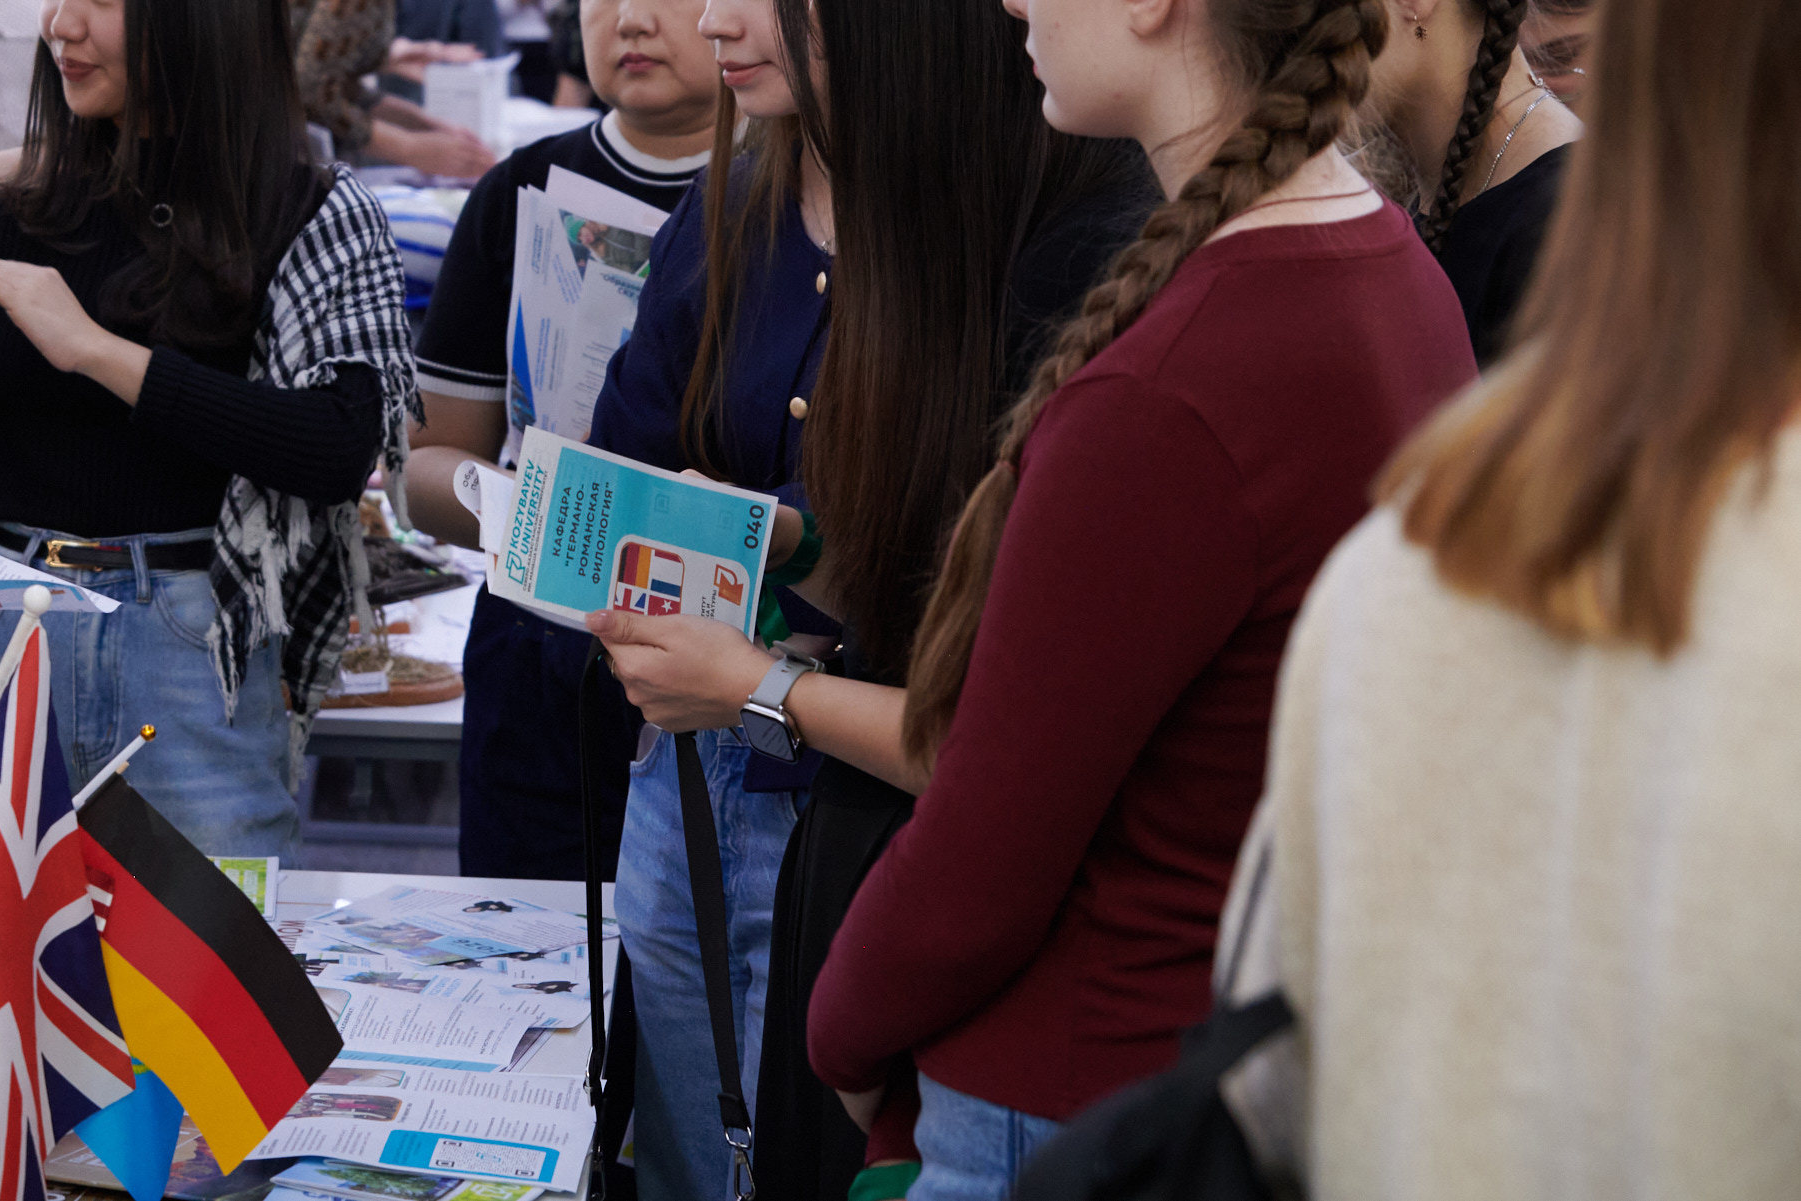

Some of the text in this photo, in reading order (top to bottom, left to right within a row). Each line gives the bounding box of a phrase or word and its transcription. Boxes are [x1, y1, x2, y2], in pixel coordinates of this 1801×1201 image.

[510, 459, 535, 549] KOZYBAYEV
[520, 465, 546, 554] UNIVERSITY
[552, 486, 572, 556] КАФЕДРА
[578, 482, 601, 576] РОМАНСКАЯ
[744, 504, 765, 549] 040
